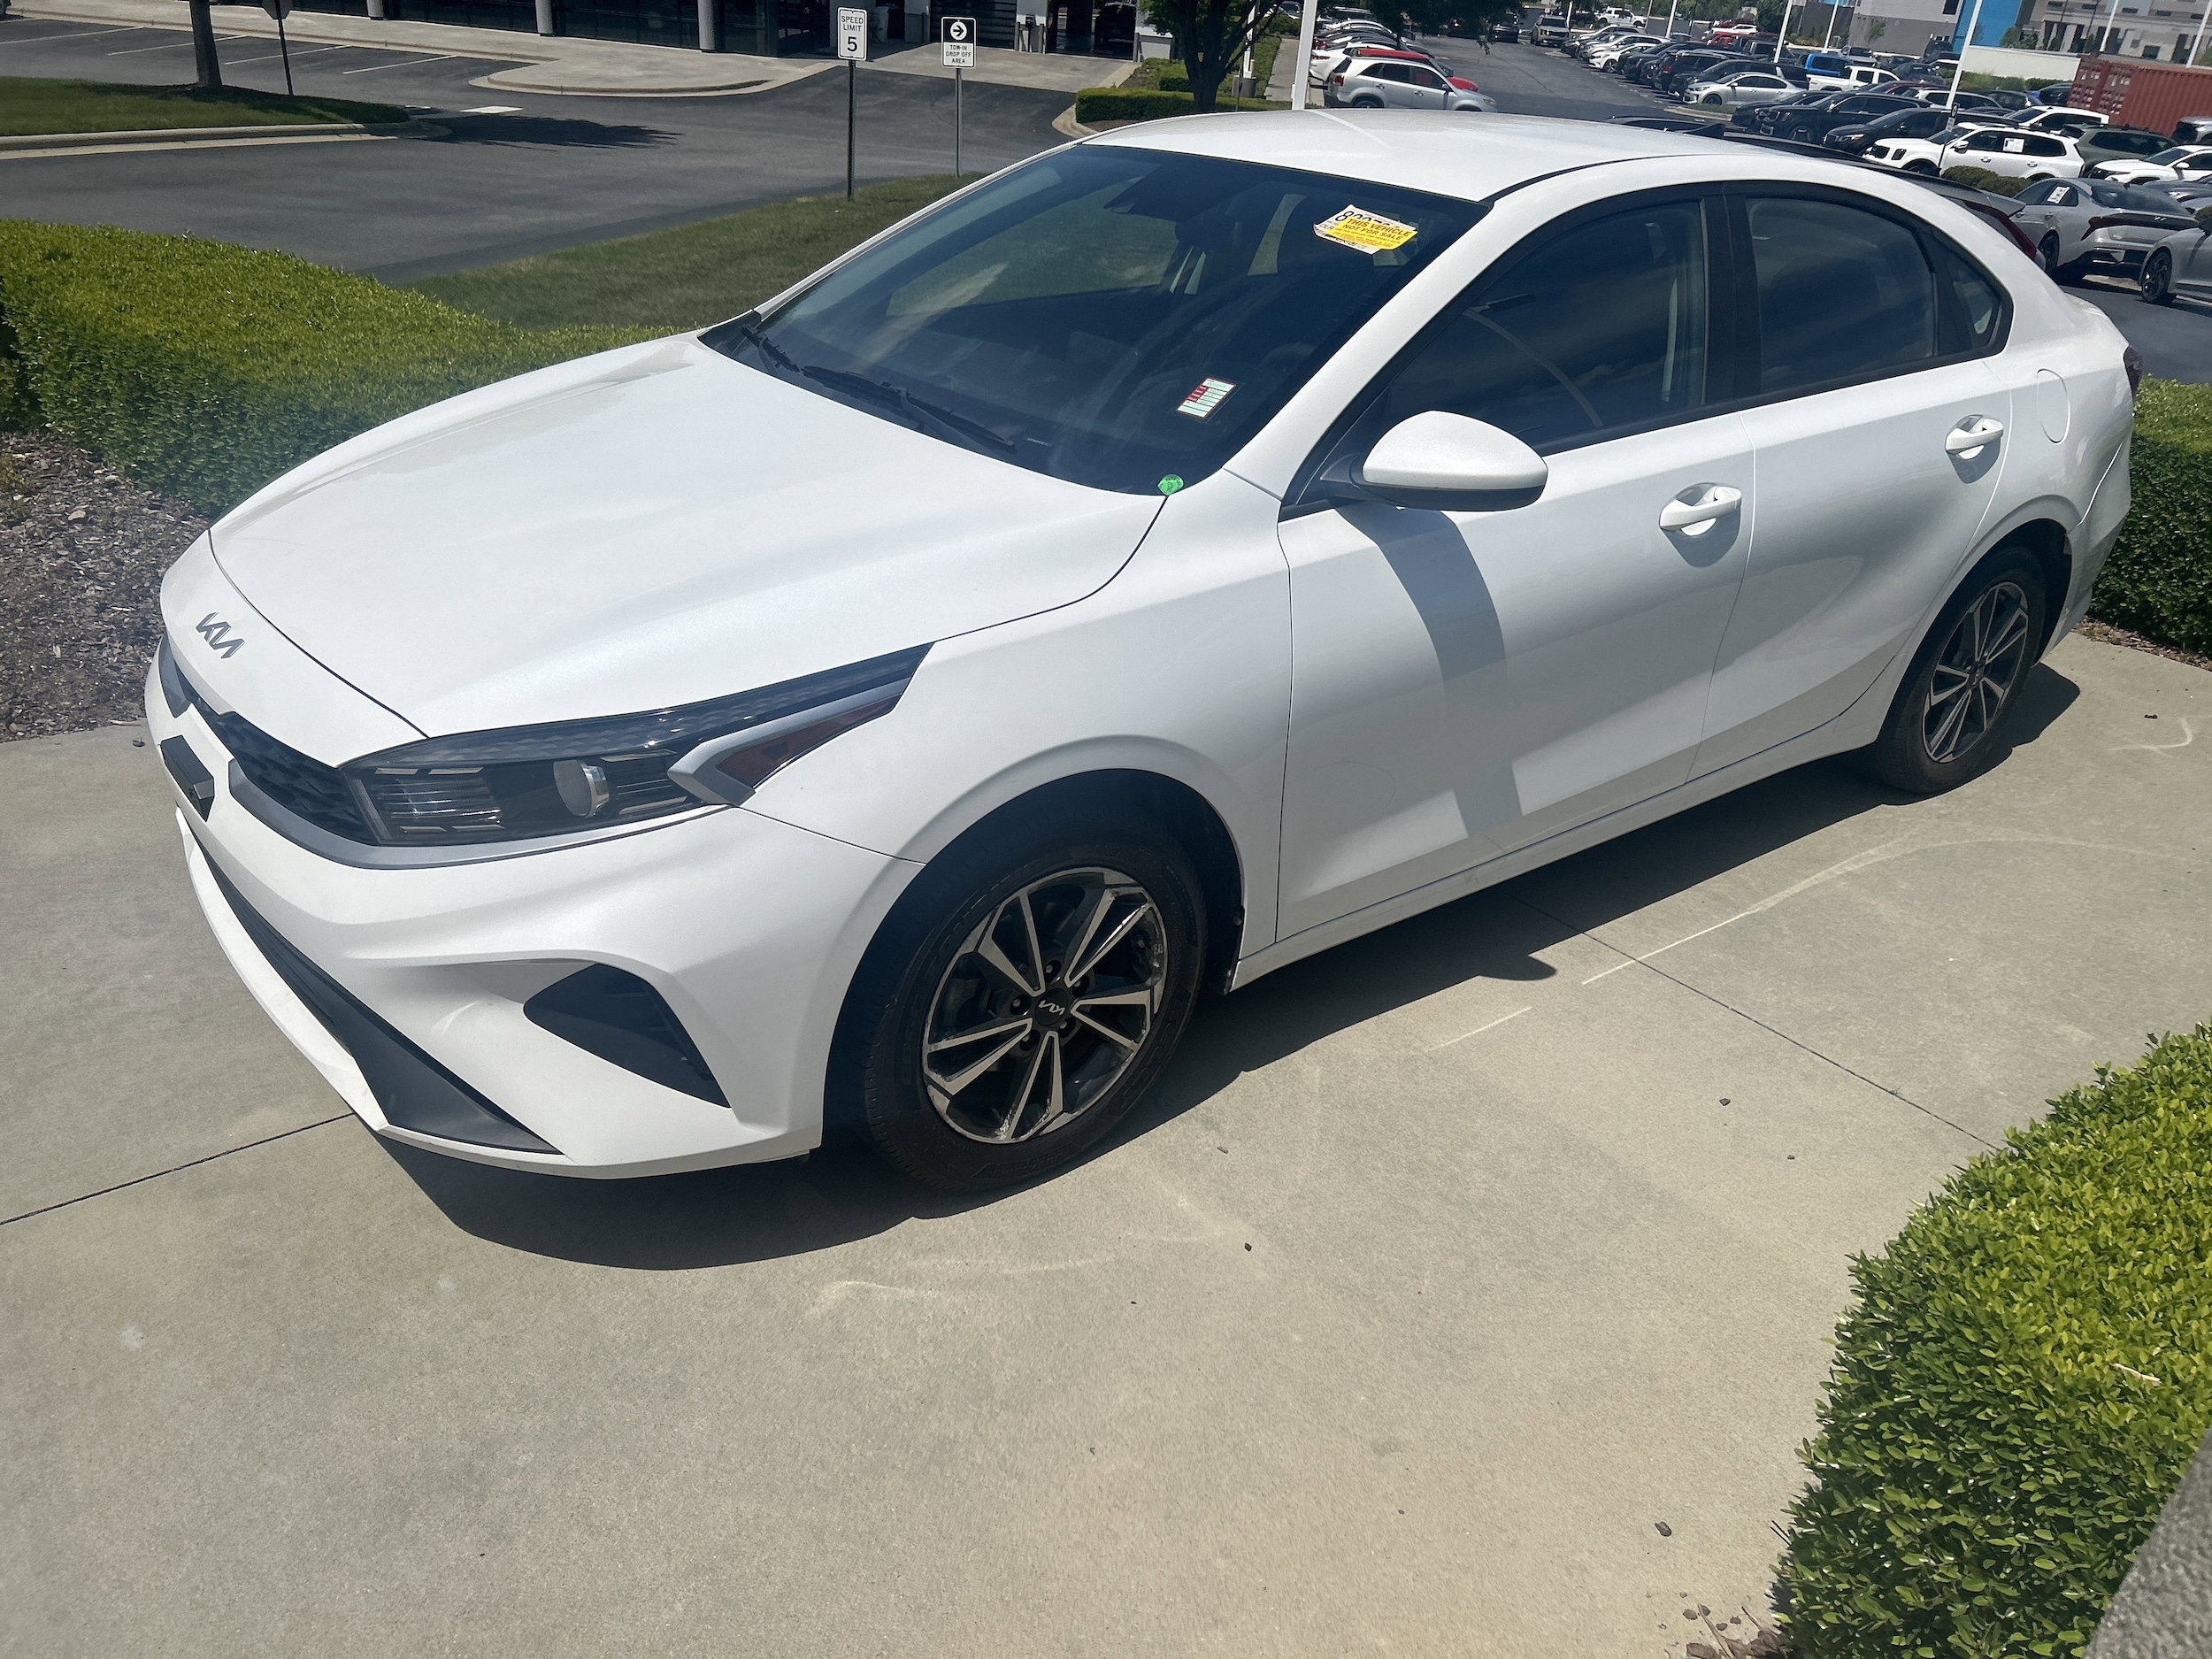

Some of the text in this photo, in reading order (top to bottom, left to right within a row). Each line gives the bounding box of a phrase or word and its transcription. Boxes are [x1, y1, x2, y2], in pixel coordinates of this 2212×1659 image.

[841, 15, 864, 25] SPEED
[847, 36, 858, 52] 5
[1347, 219, 1367, 227] THIS
[1371, 223, 1412, 237] VEHICLE
[1379, 231, 1402, 241] SALE
[196, 611, 245, 659] KIA
[1038, 999, 1065, 1016] KIA
